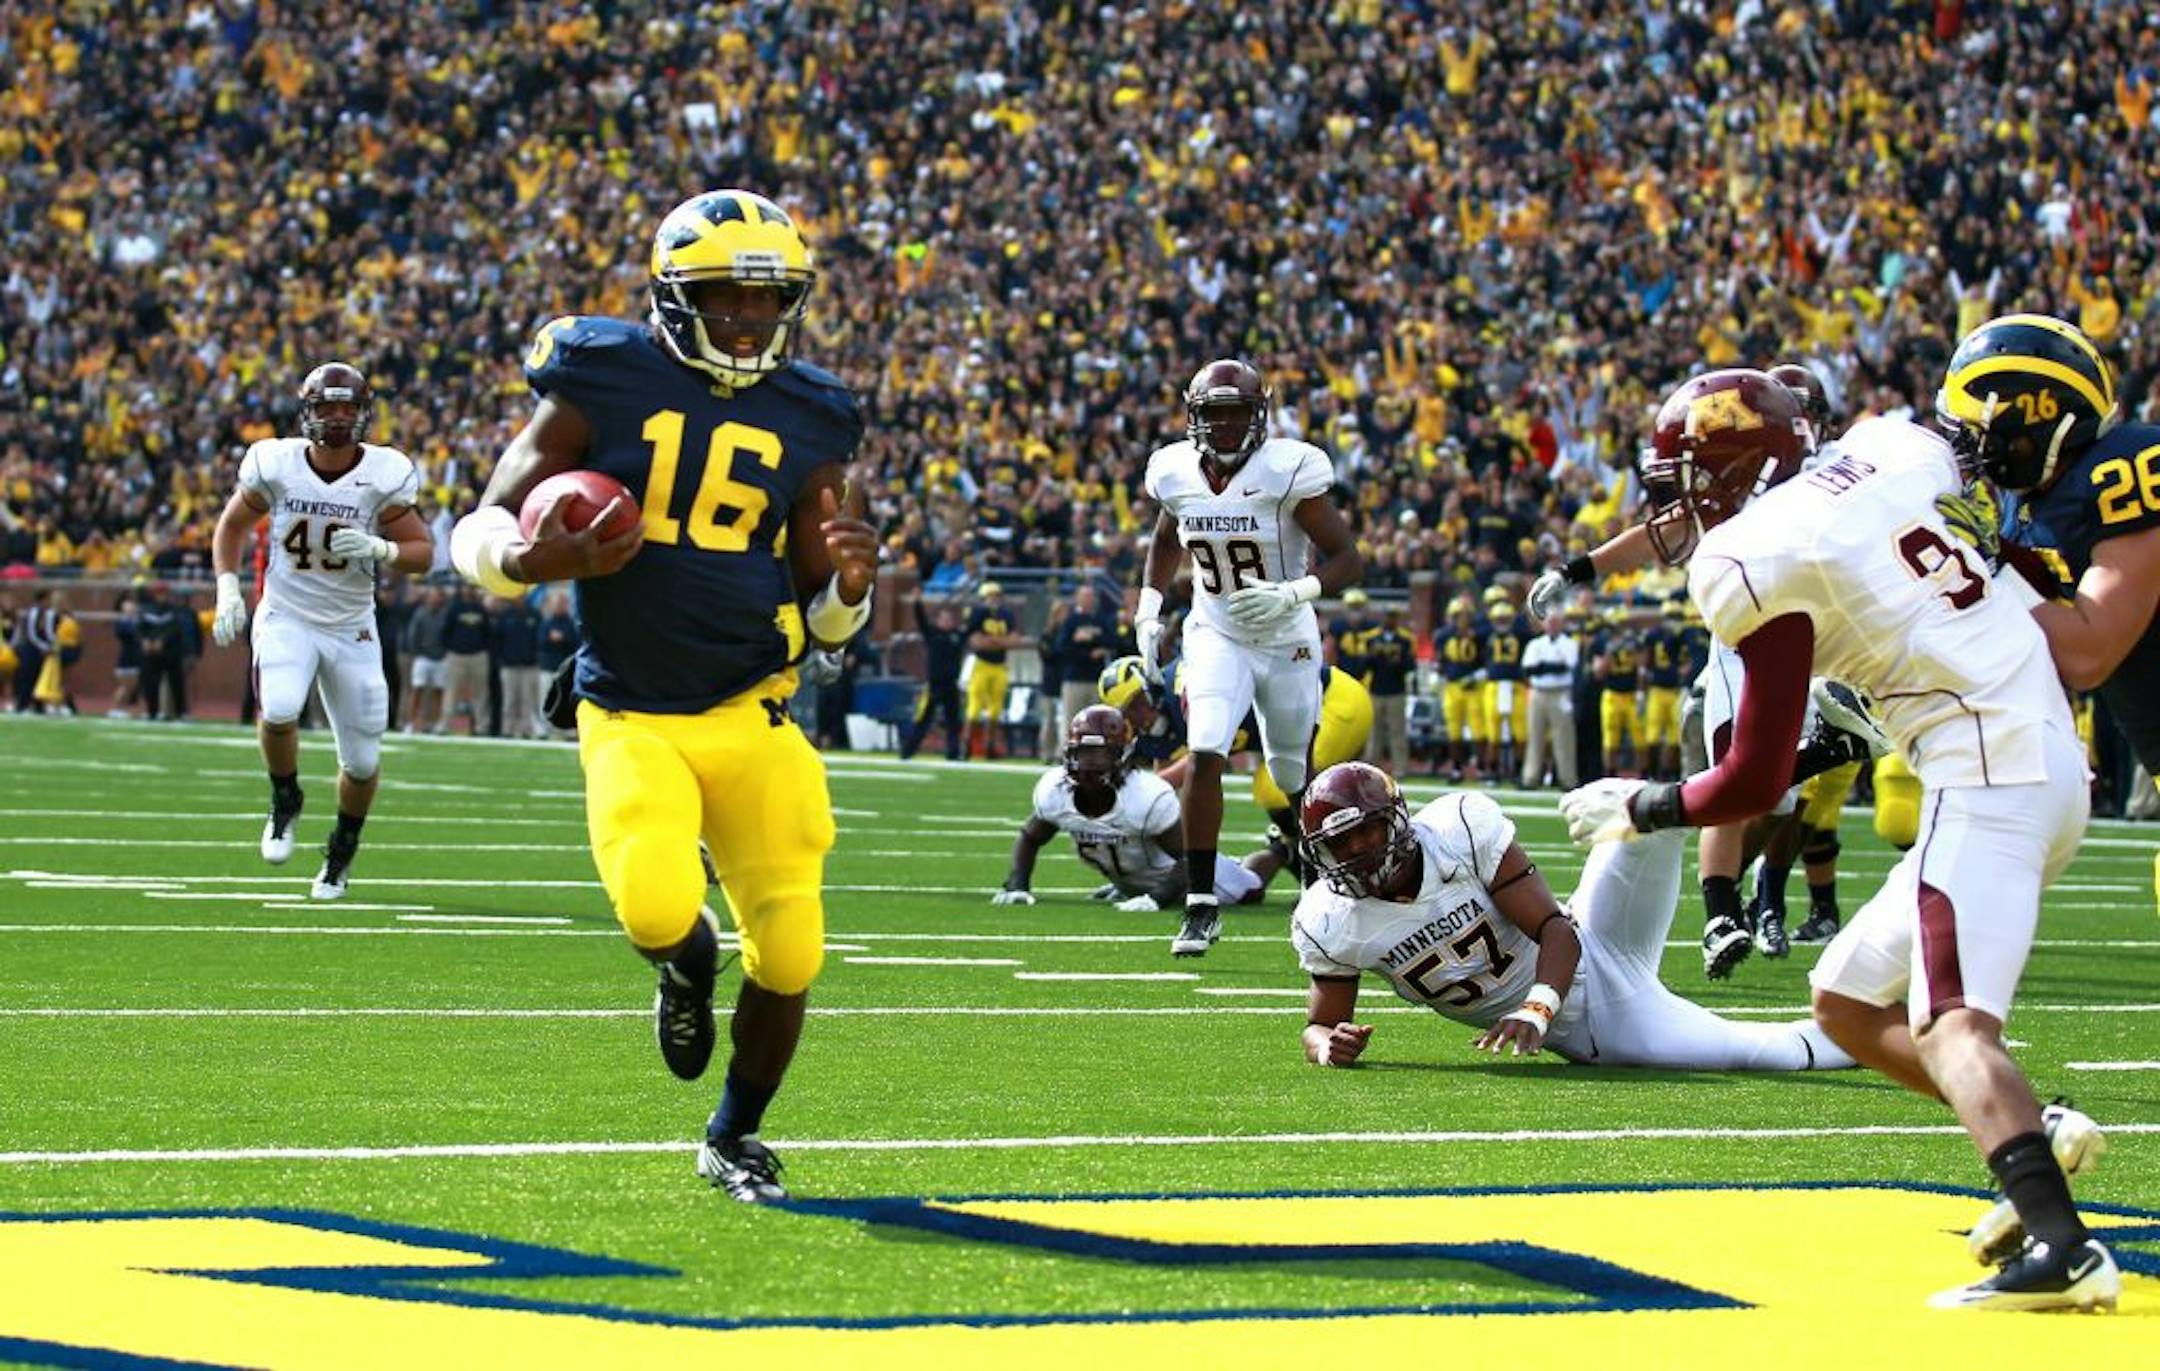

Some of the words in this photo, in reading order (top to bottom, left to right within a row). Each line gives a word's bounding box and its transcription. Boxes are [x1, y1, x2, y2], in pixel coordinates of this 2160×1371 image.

[2015, 388, 2059, 425] 26
[641, 409, 784, 553] 16
[1806, 455, 1876, 496] LEWIS
[284, 498, 360, 520] MINNESOTA
[1183, 515, 1260, 532] MINNESOTA
[1187, 539, 1267, 595] 98
[1380, 898, 1485, 969] MINNESOTA
[1401, 919, 1516, 1007] 57
